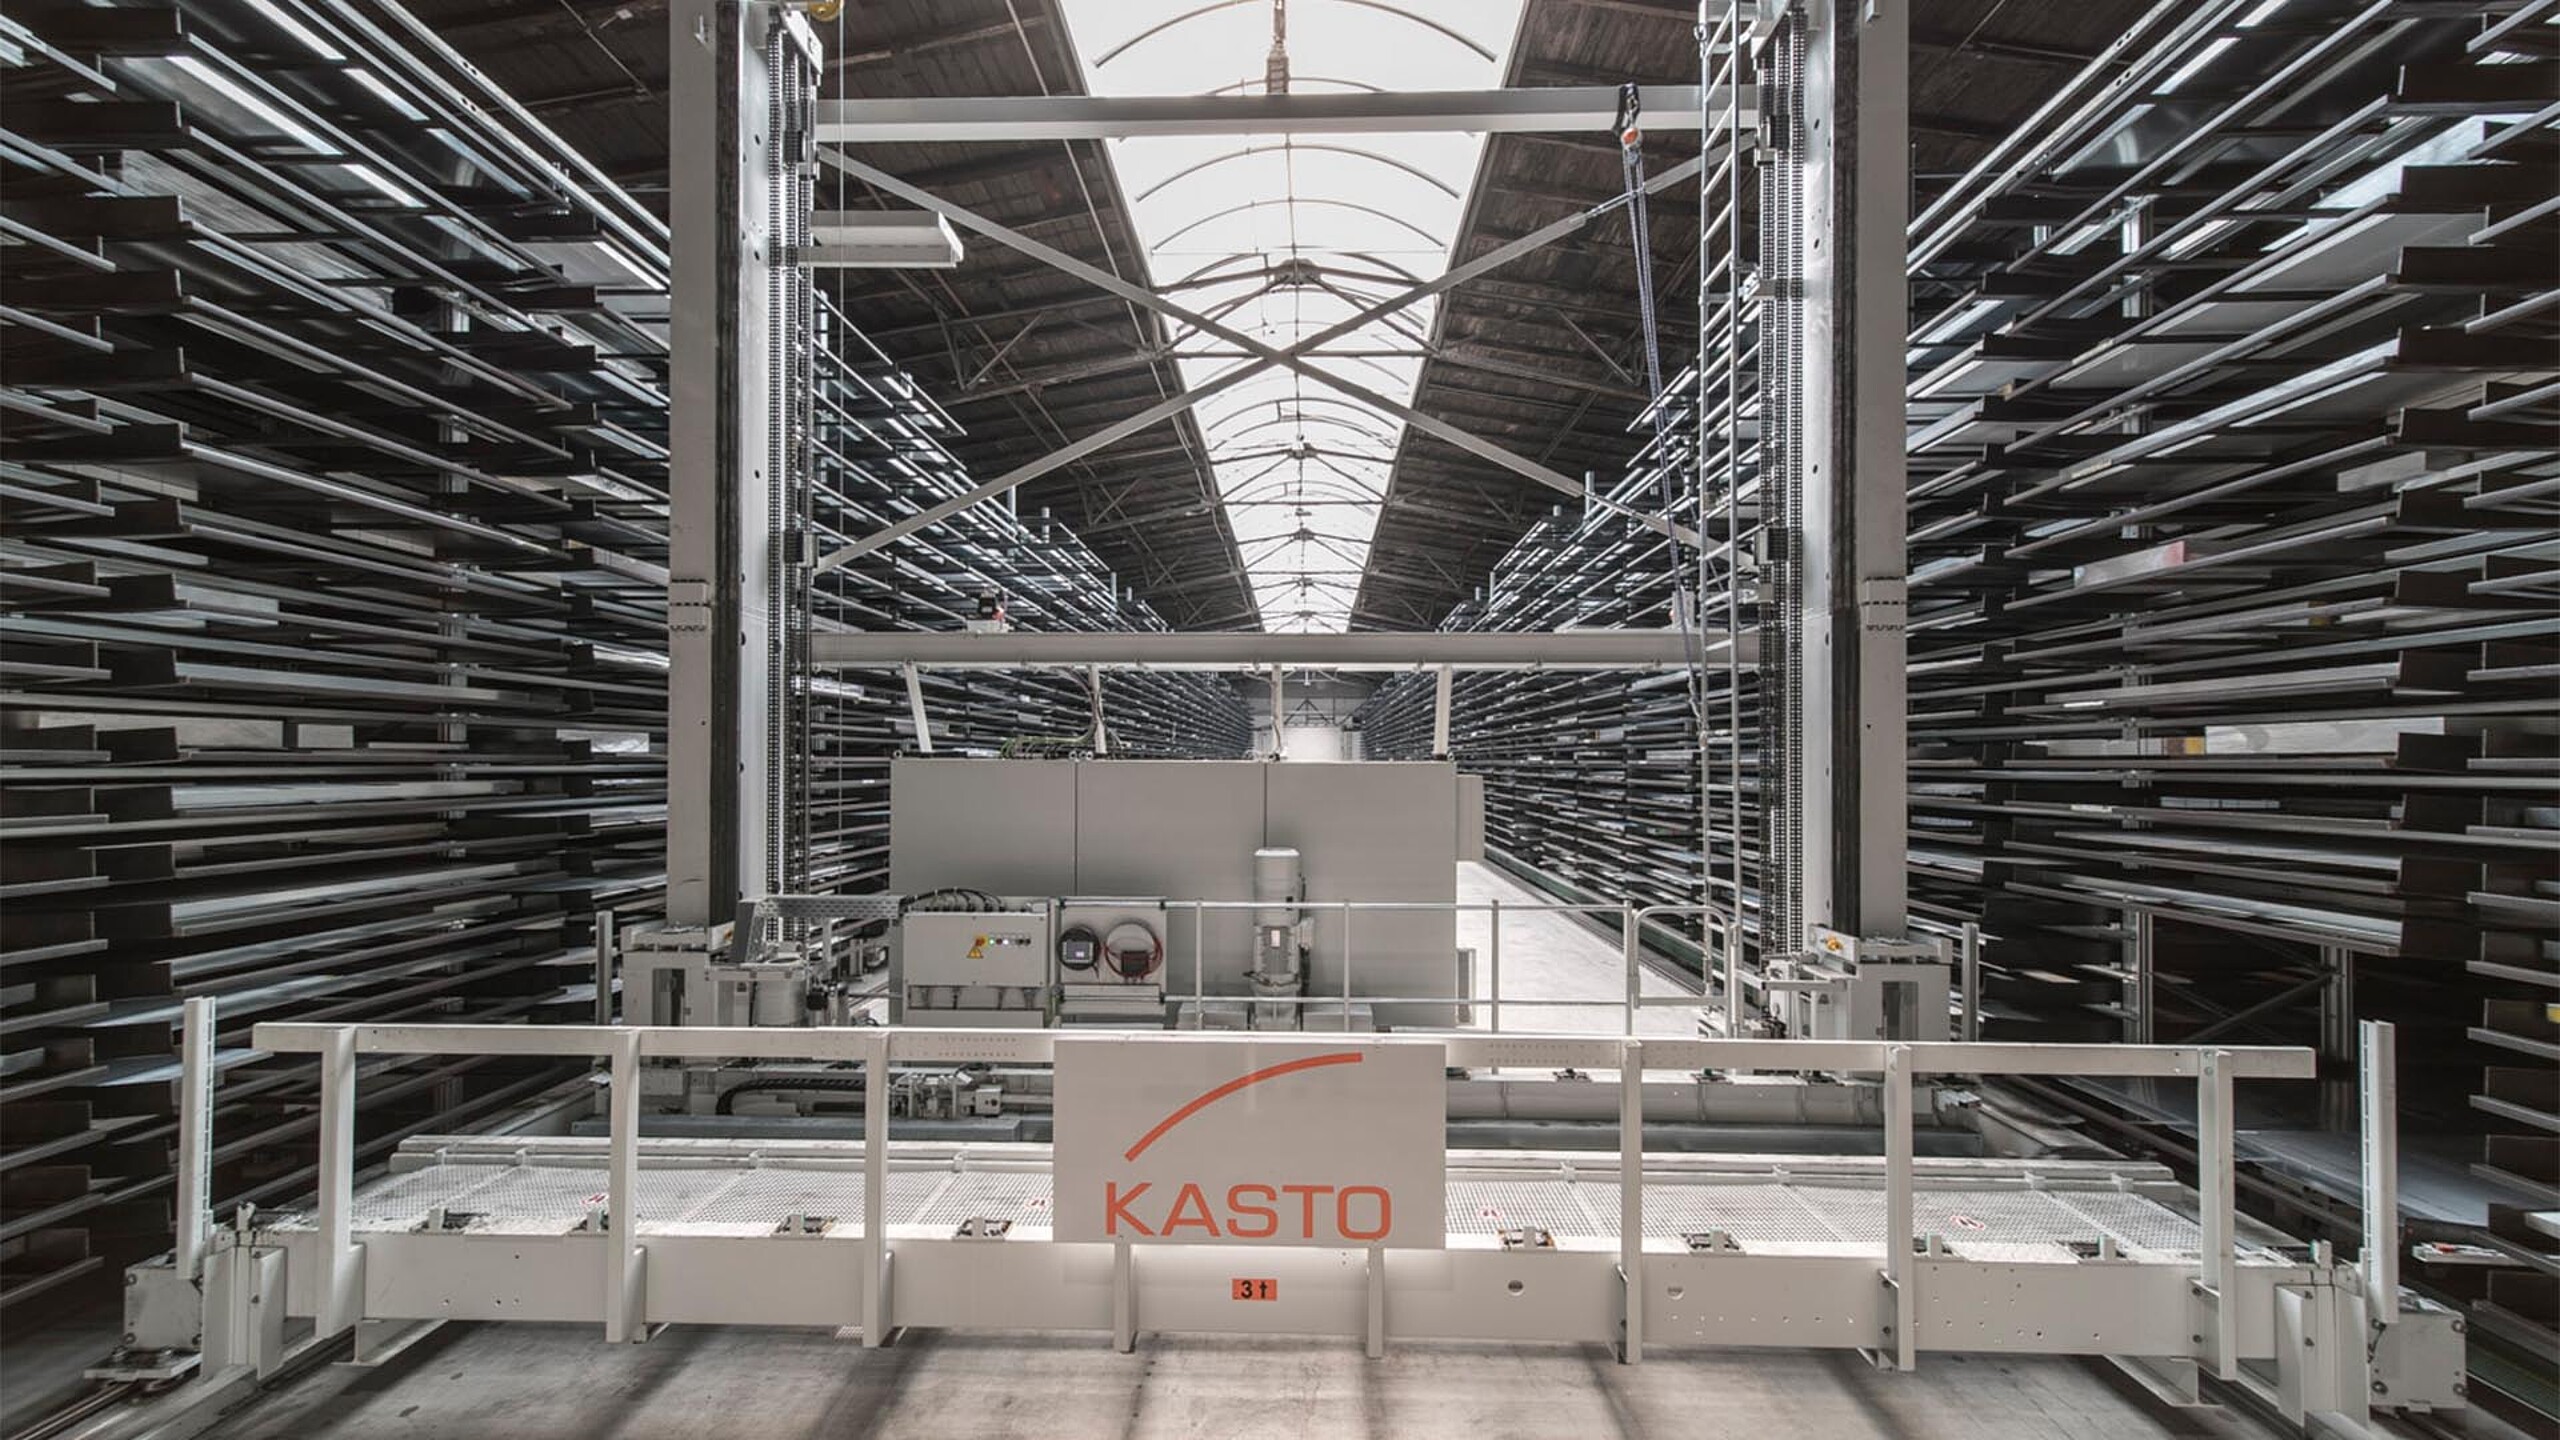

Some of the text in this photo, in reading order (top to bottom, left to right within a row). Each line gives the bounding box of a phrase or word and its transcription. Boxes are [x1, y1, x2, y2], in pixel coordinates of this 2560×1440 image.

[1104, 1181, 1392, 1241] KASTO
[1241, 1280, 1268, 1299] 3 t
